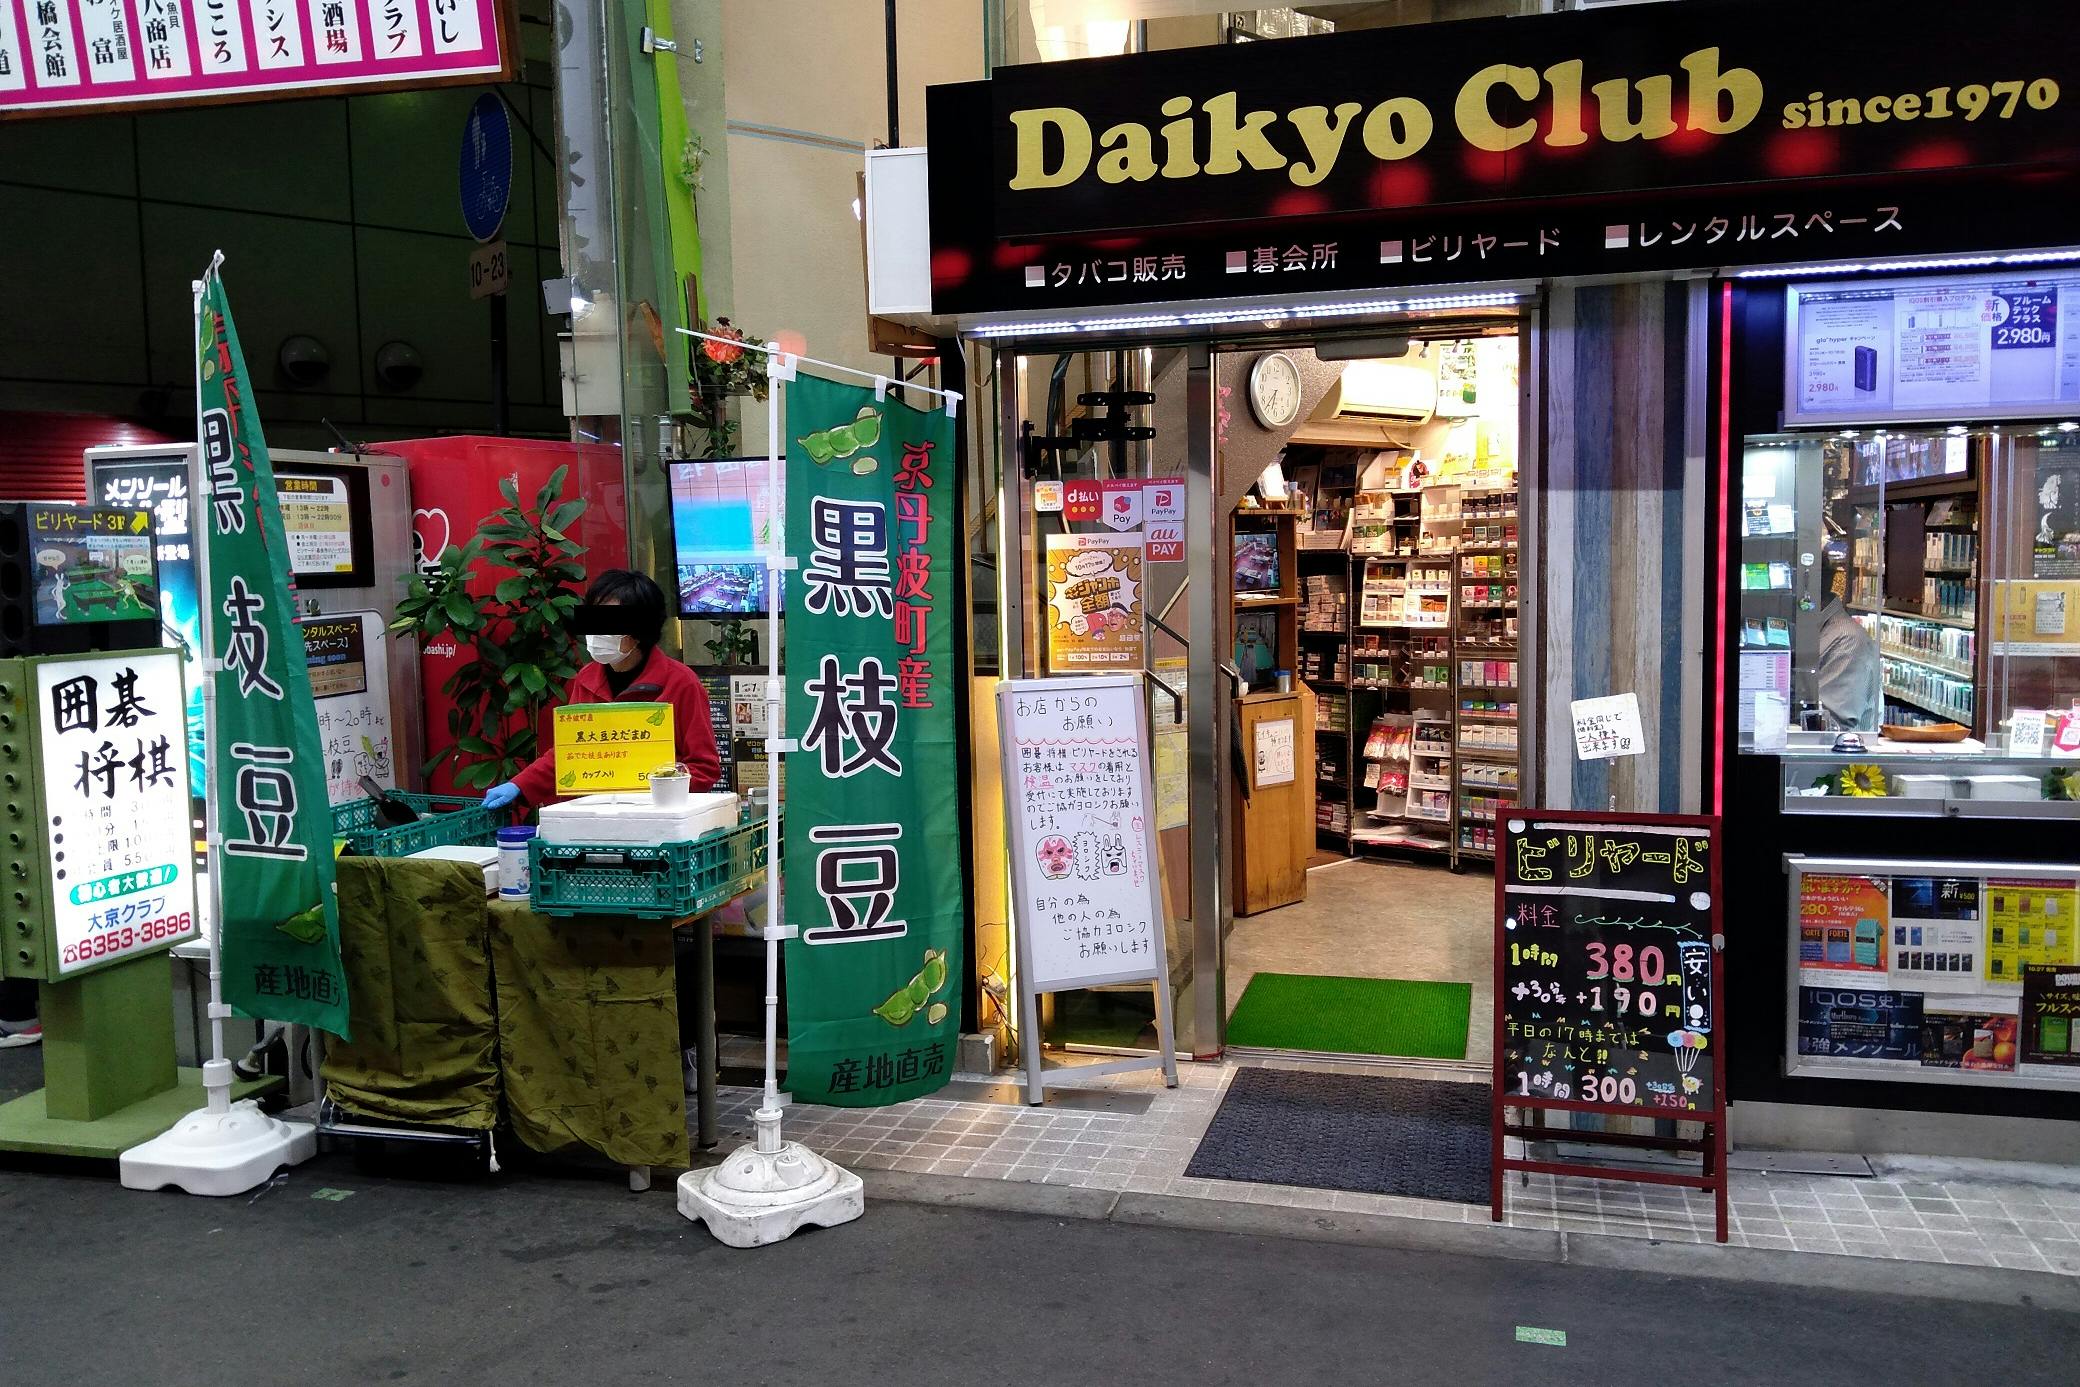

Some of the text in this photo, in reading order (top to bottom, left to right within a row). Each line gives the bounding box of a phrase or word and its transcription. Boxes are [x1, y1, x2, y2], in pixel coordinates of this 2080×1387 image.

[265, 0, 290, 58] シス
[384, 0, 408, 53] ラブ
[1009, 47, 2060, 191] Daikyo Club since1970
[1051, 206, 1903, 287] タバコ販売 碁会所 ビリヤード レンタルスペース
[471, 252, 505, 288] 10-23
[2012, 305, 2040, 314] テック
[104, 475, 187, 501] メンソール
[284, 480, 318, 491] 営業時間
[1067, 488, 1099, 503] d払い
[36, 512, 103, 531] ビリヤード
[107, 515, 125, 530] 3F
[1113, 513, 1131, 524] Pay
[1151, 507, 1177, 516] PayPay
[1087, 538, 1111, 546] PayPay
[1150, 528, 1179, 540] au
[1152, 543, 1177, 556] PAY
[893, 440, 936, 709] 京丹波町産
[51, 667, 157, 734] 囲碁
[1016, 696, 1098, 717] お店からの
[804, 495, 908, 945] 黒枝豆
[1062, 714, 1114, 731] お願い
[575, 729, 651, 743] 黒大豆えだまめ
[74, 734, 177, 799] 将棋
[582, 770, 615, 779] カップ入り
[1516, 835, 1709, 884] ビリヤード
[88, 896, 166, 932] 大京クラブ
[1517, 903, 1561, 928] 料金
[79, 912, 191, 960] 6353-3696
[1079, 938, 1149, 959] お願いします
[1507, 1022, 1640, 1046] 平日の17時までは
[827, 1042, 945, 1094] 産地直売
